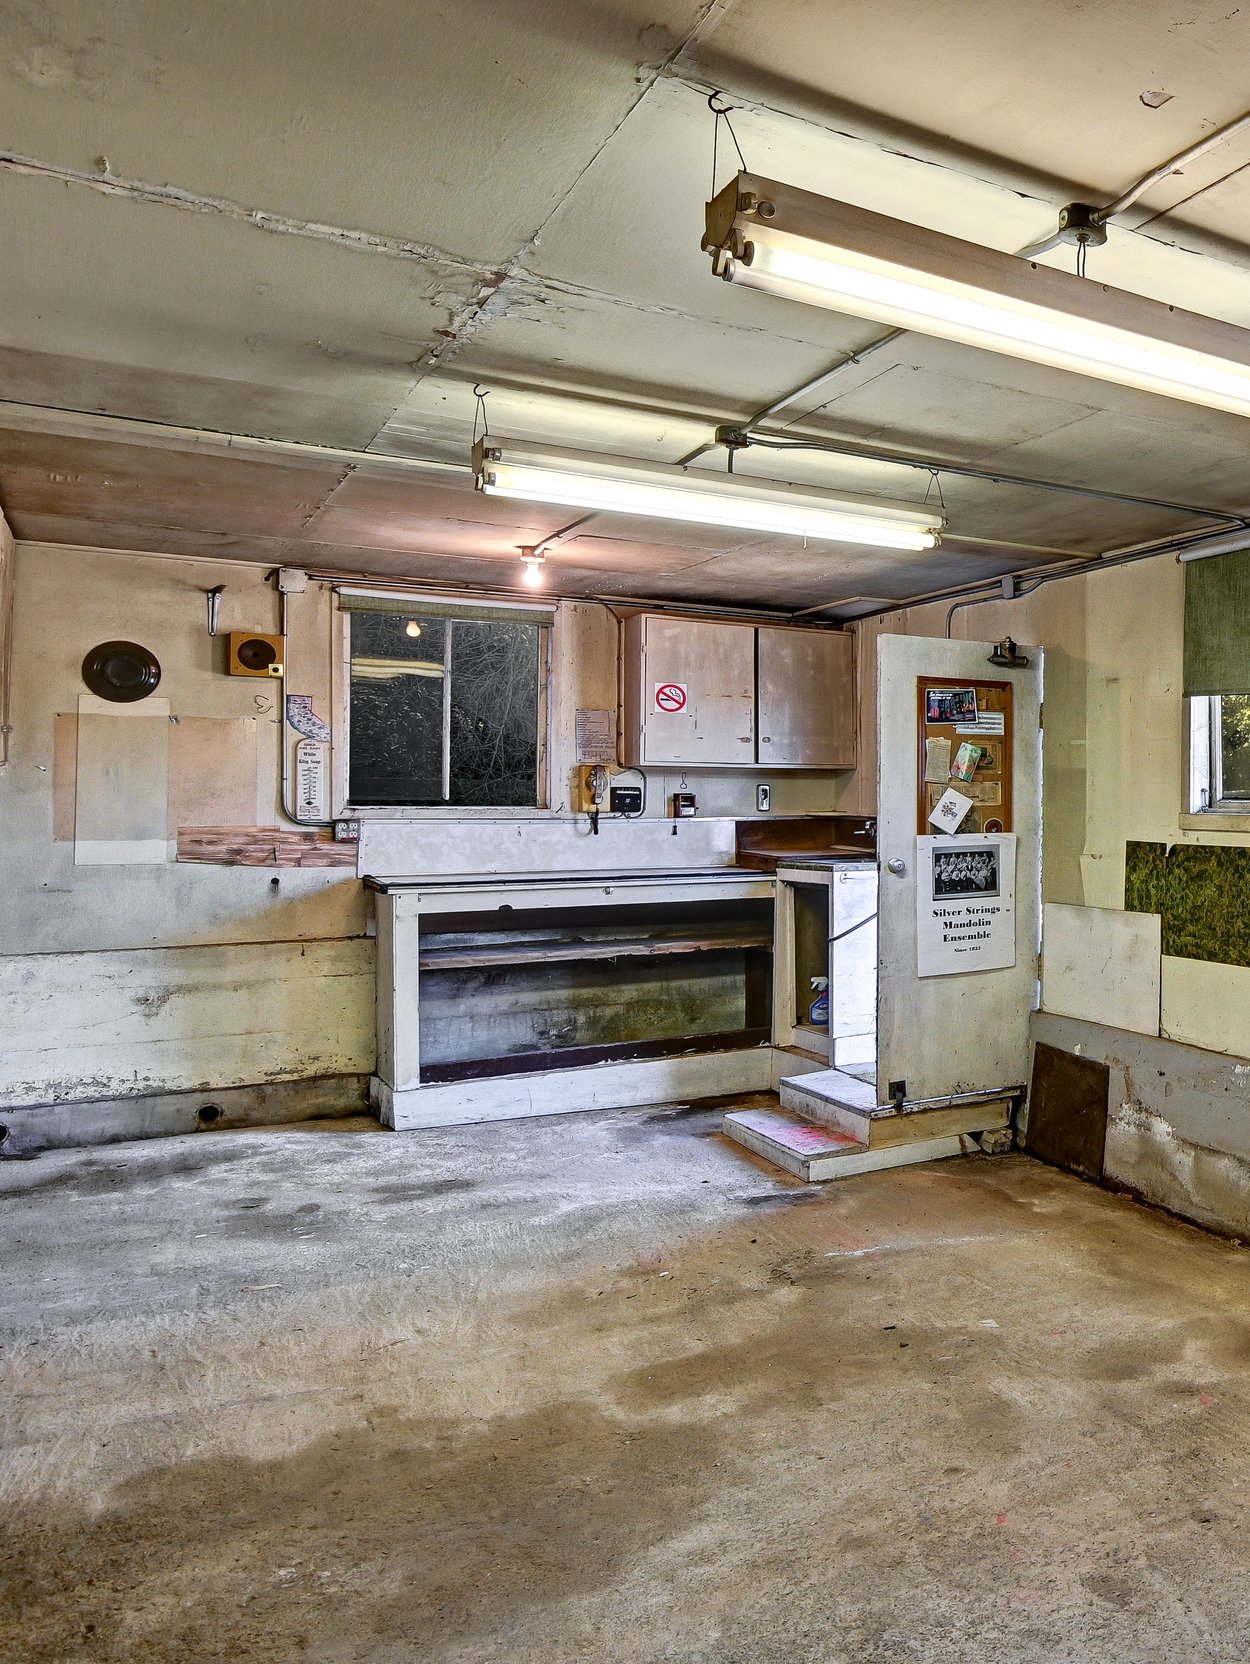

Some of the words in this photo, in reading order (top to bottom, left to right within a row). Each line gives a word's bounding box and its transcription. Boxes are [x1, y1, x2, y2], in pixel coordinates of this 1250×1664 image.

[932, 908, 962, 918] Silver
[965, 905, 1000, 915] Strings
[943, 918, 991, 930] Mandolin
[943, 930, 991, 943] Ensemble
